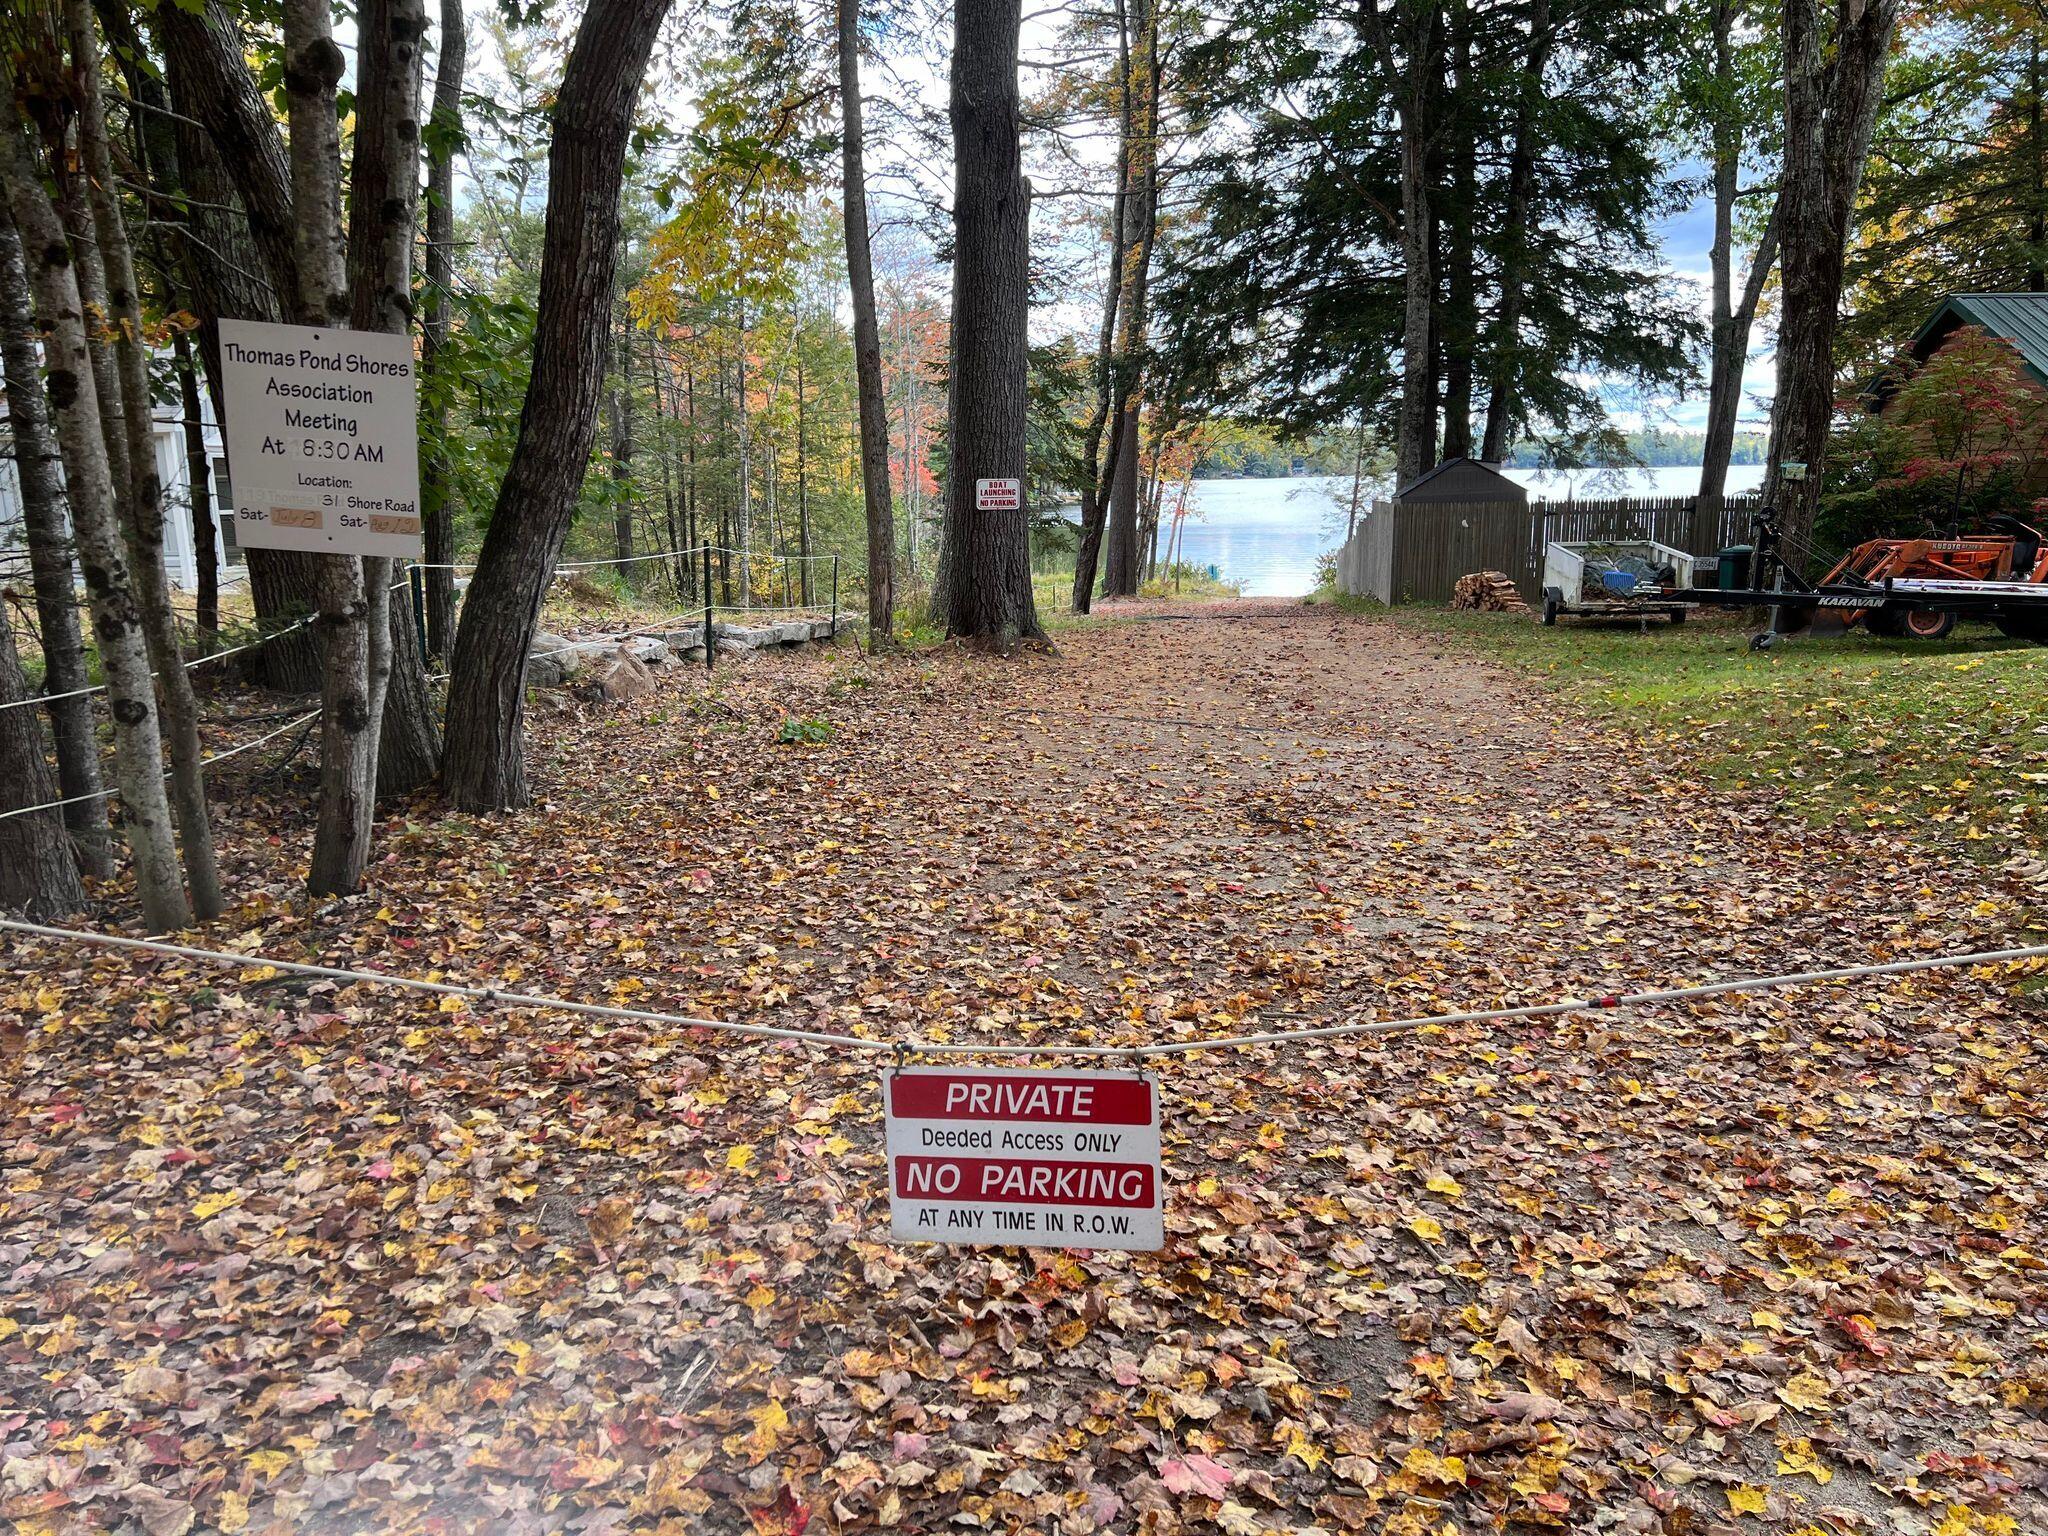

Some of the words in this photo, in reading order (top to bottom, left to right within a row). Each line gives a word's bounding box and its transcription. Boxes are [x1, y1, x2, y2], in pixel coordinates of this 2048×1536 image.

[225, 343, 295, 367] Thomas
[300, 350, 341, 372] Pond
[346, 354, 409, 377] Shores
[266, 377, 373, 404] Association
[285, 409, 357, 436] Meeting
[261, 436, 286, 455] At
[354, 443, 383, 463] AM
[298, 473, 352, 488] Location:
[240, 508, 269, 521] Sat-
[347, 496, 382, 509] Shore
[385, 498, 415, 513] Road
[340, 515, 368, 527] Sat-
[1817, 597, 1885, 607] KARAVAN
[945, 1082, 1094, 1116] PRIVATE
[922, 1127, 992, 1149] Deeded
[1002, 1130, 1063, 1151] Access
[1074, 1133, 1122, 1153] ONLY
[906, 1162, 961, 1194] NO
[981, 1165, 1143, 1201] PARKING
[918, 1208, 939, 1227] AT
[948, 1209, 984, 1229] ANY
[992, 1211, 1036, 1231] TIME
[1045, 1213, 1063, 1232] IN
[1074, 1214, 1135, 1235] R.O.W.
